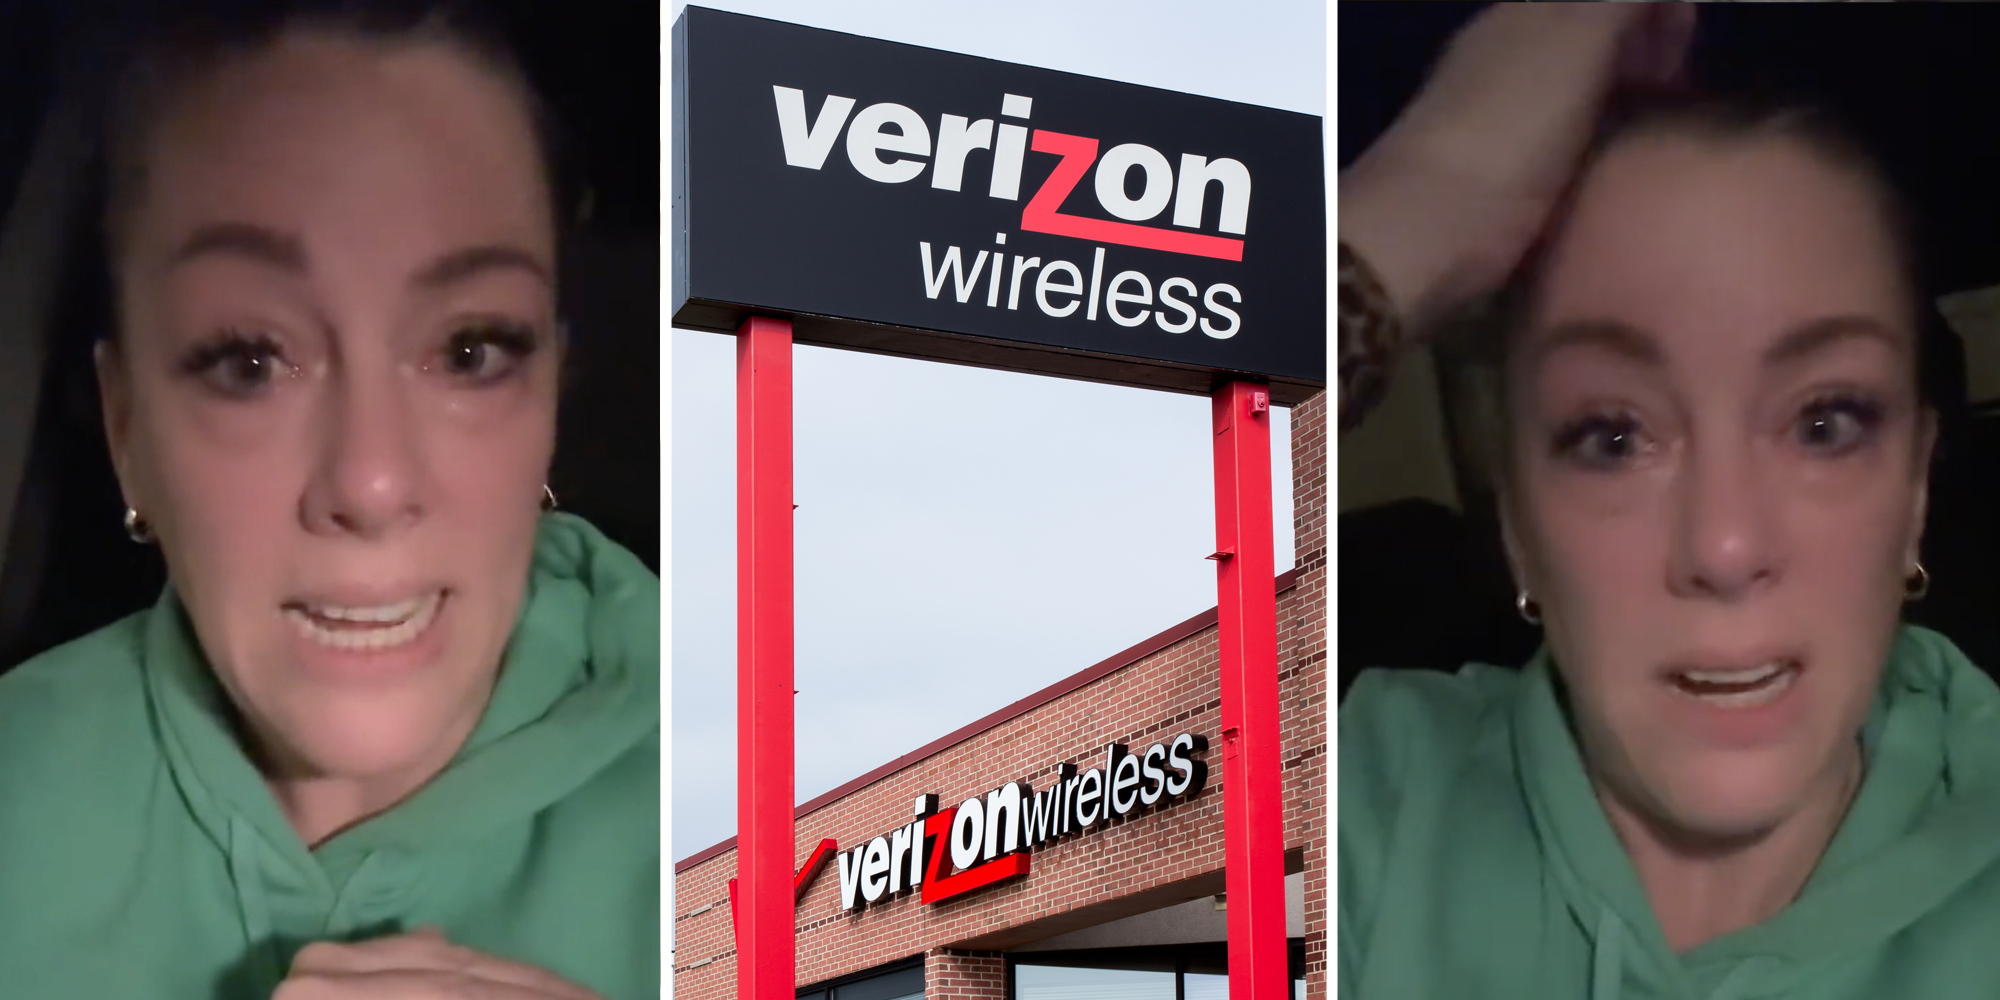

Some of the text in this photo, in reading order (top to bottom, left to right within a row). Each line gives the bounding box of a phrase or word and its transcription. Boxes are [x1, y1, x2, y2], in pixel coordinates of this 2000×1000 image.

[772, 84, 1252, 262] verizon
[919, 232, 1243, 340] wireless
[836, 731, 1196, 910] verizon wireless
